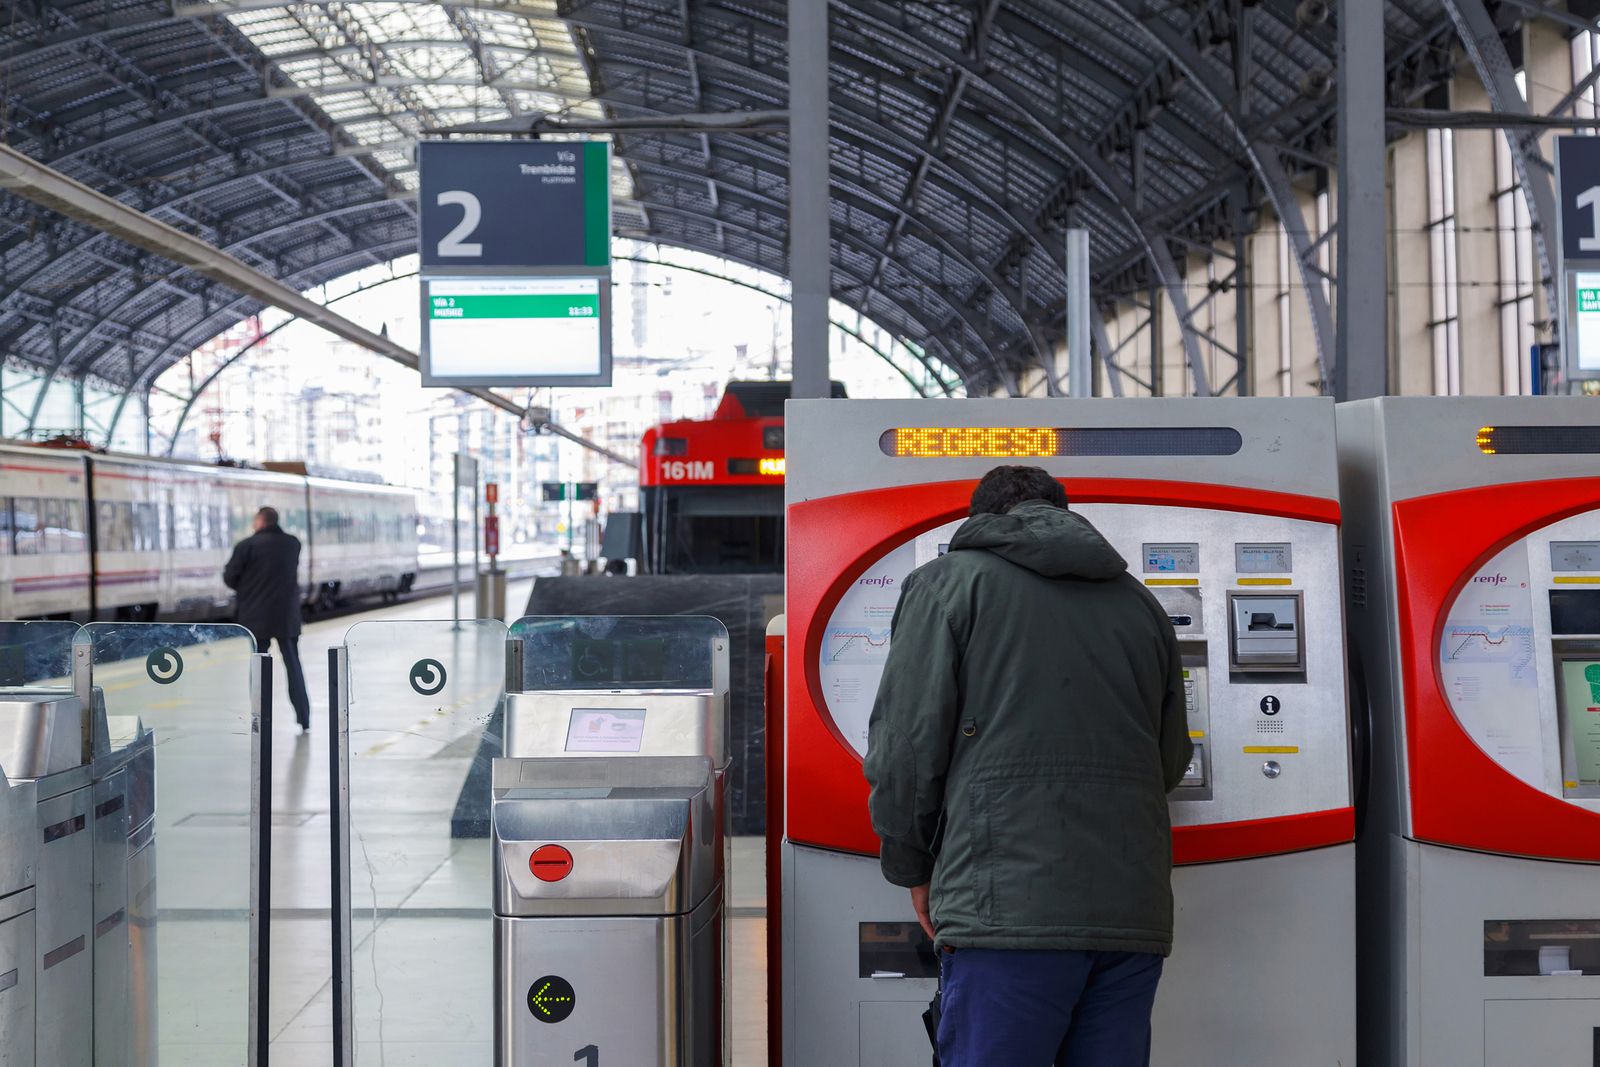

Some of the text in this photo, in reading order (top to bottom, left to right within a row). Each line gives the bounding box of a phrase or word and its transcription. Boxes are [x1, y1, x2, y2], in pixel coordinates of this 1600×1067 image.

[437, 190, 482, 257] 2
[897, 428, 1057, 456] REGRESO
[662, 461, 714, 480] 161M
[860, 575, 894, 588] renfe
[1473, 573, 1507, 586] renfe
